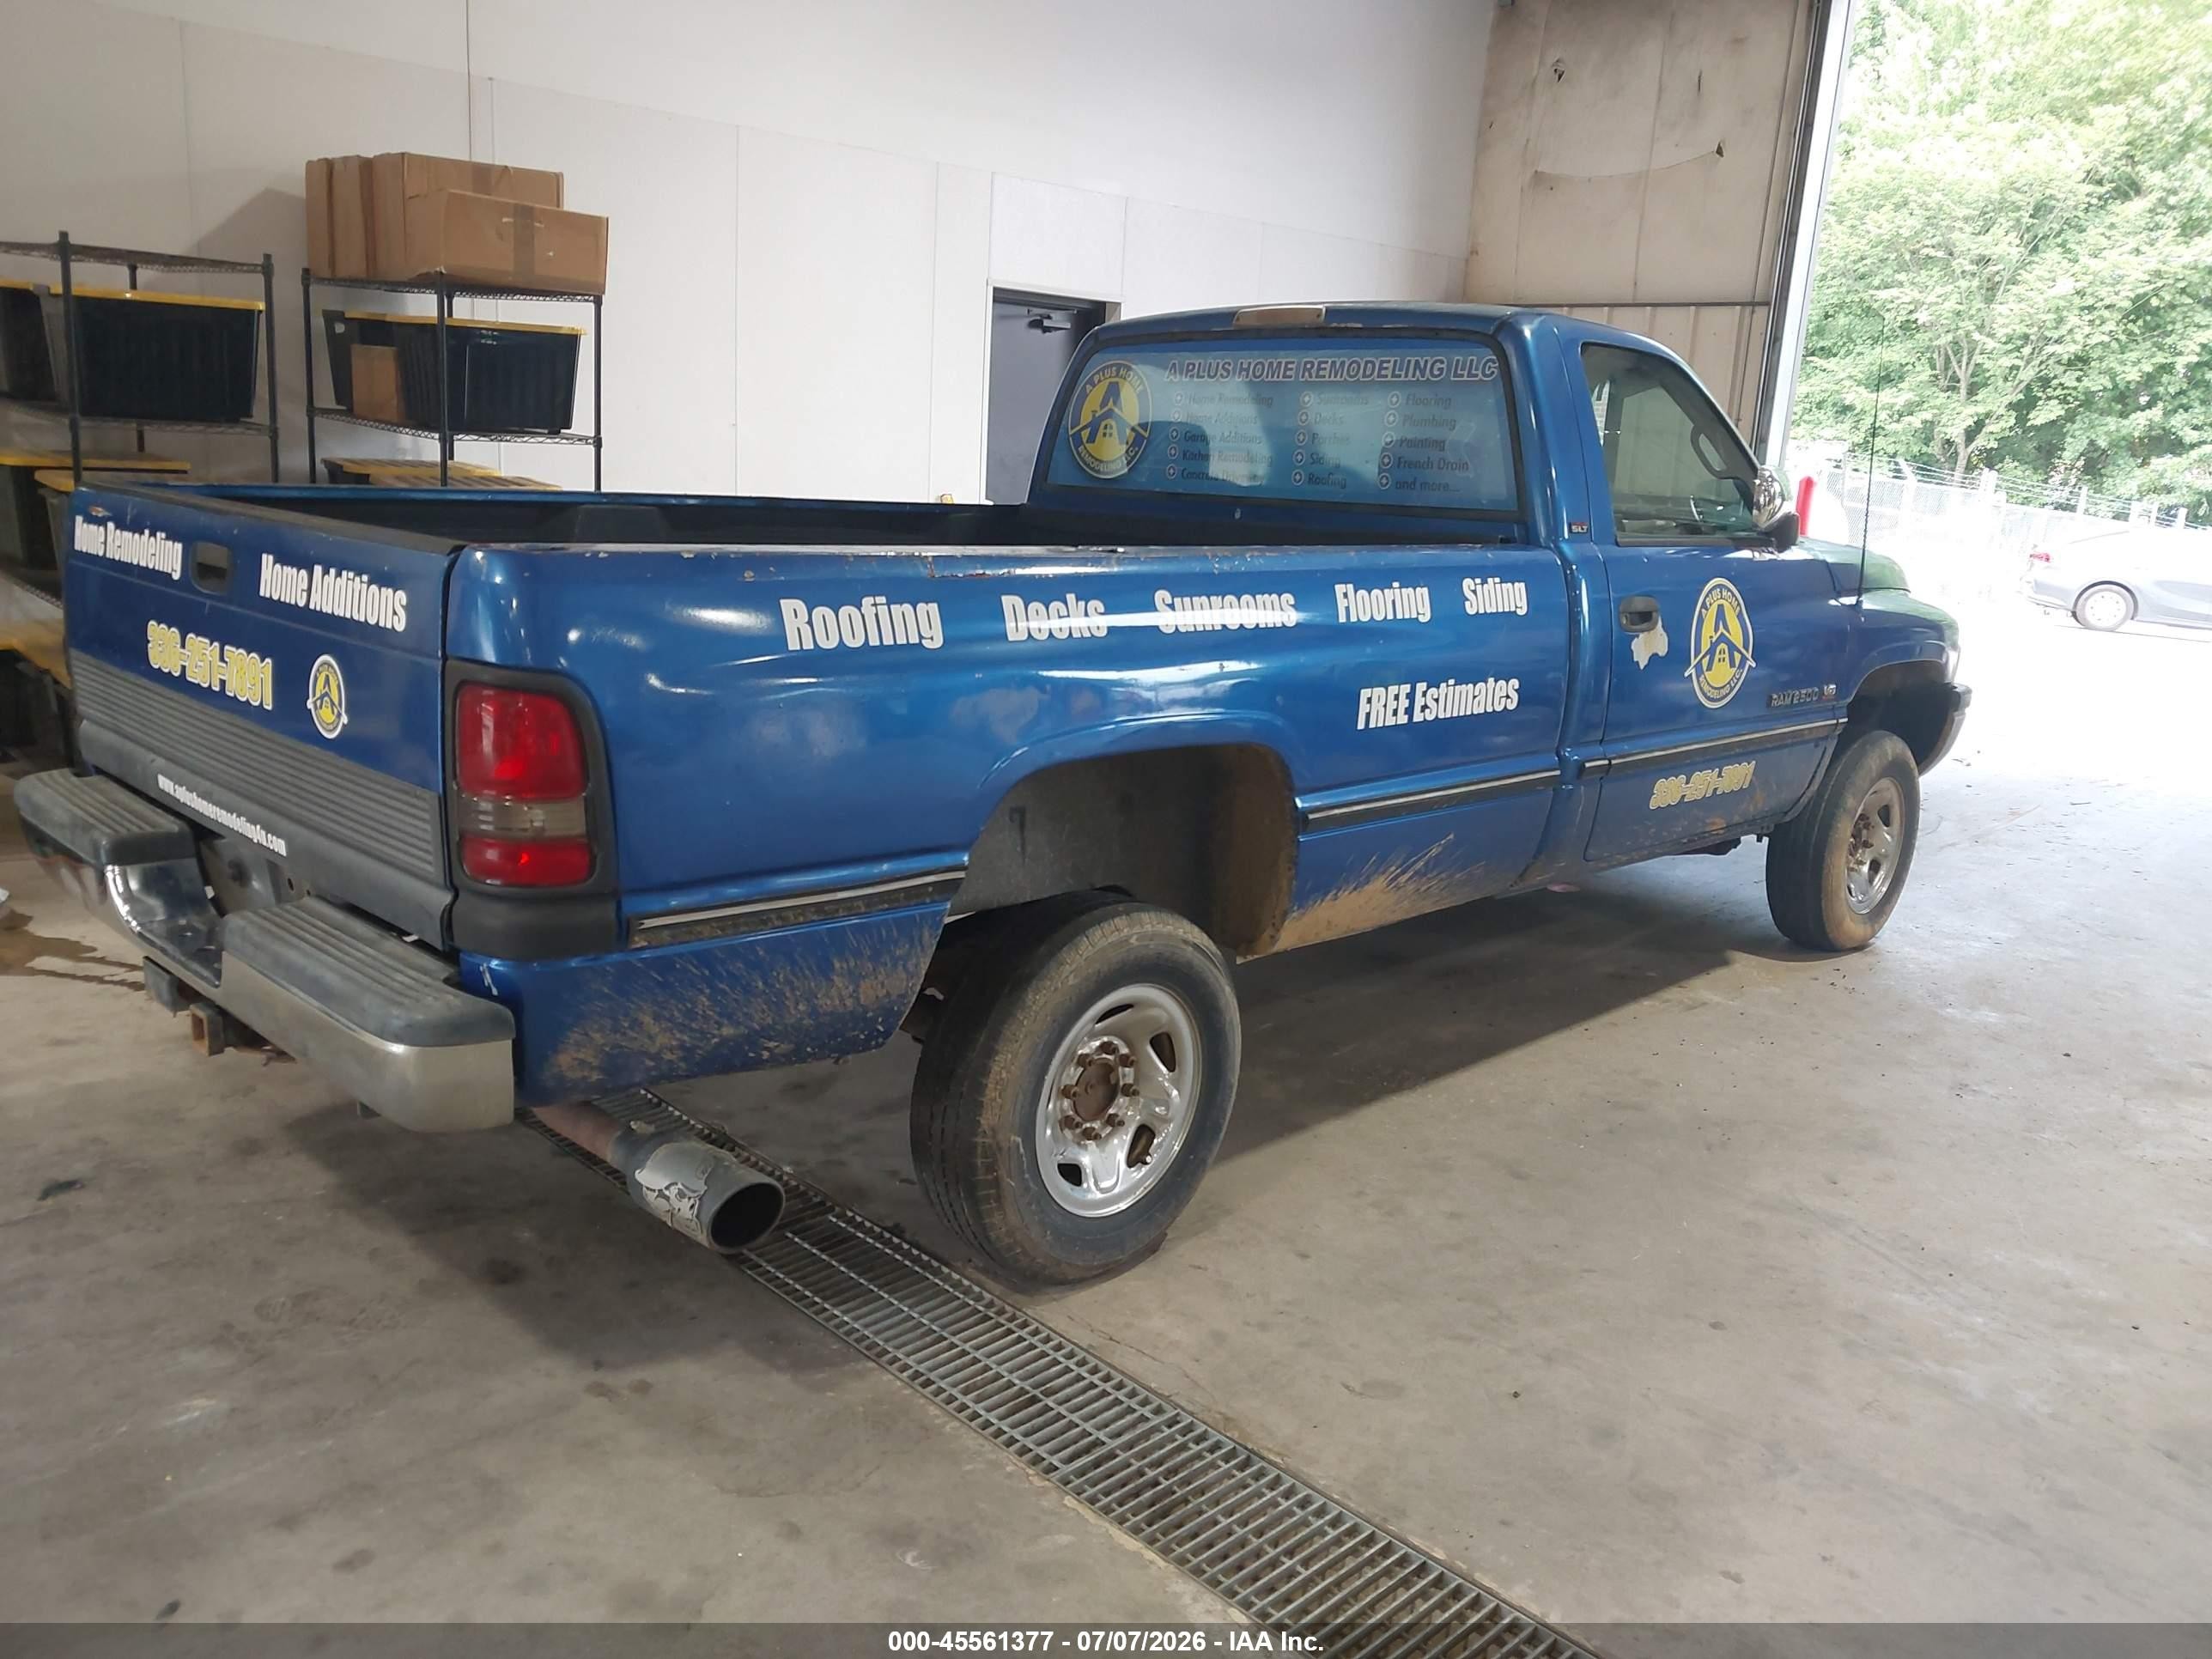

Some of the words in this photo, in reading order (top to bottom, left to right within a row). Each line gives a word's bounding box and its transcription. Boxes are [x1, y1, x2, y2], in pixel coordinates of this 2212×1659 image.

[1094, 367, 1117, 385] PLUS
[1119, 367, 1145, 395] HOME
[1164, 361, 1178, 381] A
[1182, 359, 1232, 381] PLUS
[1236, 358, 1295, 381] HOME
[1299, 356, 1448, 381] REMODELING
[1450, 356, 1499, 381] LLC
[1405, 392, 1452, 410] Flooring
[1402, 412, 1456, 430] Plumbing
[1077, 444, 1122, 472] REMODELING
[1399, 435, 1446, 453] Painting
[1310, 452, 1341, 469] Siding
[1397, 456, 1435, 471] French
[1437, 457, 1469, 472] Drain
[1308, 471, 1347, 489] Roofing
[1395, 477, 1417, 490] and
[74, 515, 105, 557] Home
[106, 521, 183, 580] Remodeling
[259, 552, 308, 607] Home
[309, 564, 406, 632] Additions
[1334, 580, 1431, 623] Flooring
[1462, 577, 1528, 616] Siding
[1706, 588, 1722, 609] PLUS
[1722, 587, 1741, 617] HOME
[779, 595, 944, 651] Roofing
[1000, 592, 1108, 642] Decks
[1154, 588, 1297, 634] Sunrooms
[147, 619, 273, 711] 336-251-7891
[1356, 684, 1411, 732] FREE
[1413, 677, 1520, 723] Estimates
[1771, 690, 1792, 708] RAM
[1793, 687, 1820, 704] 2500
